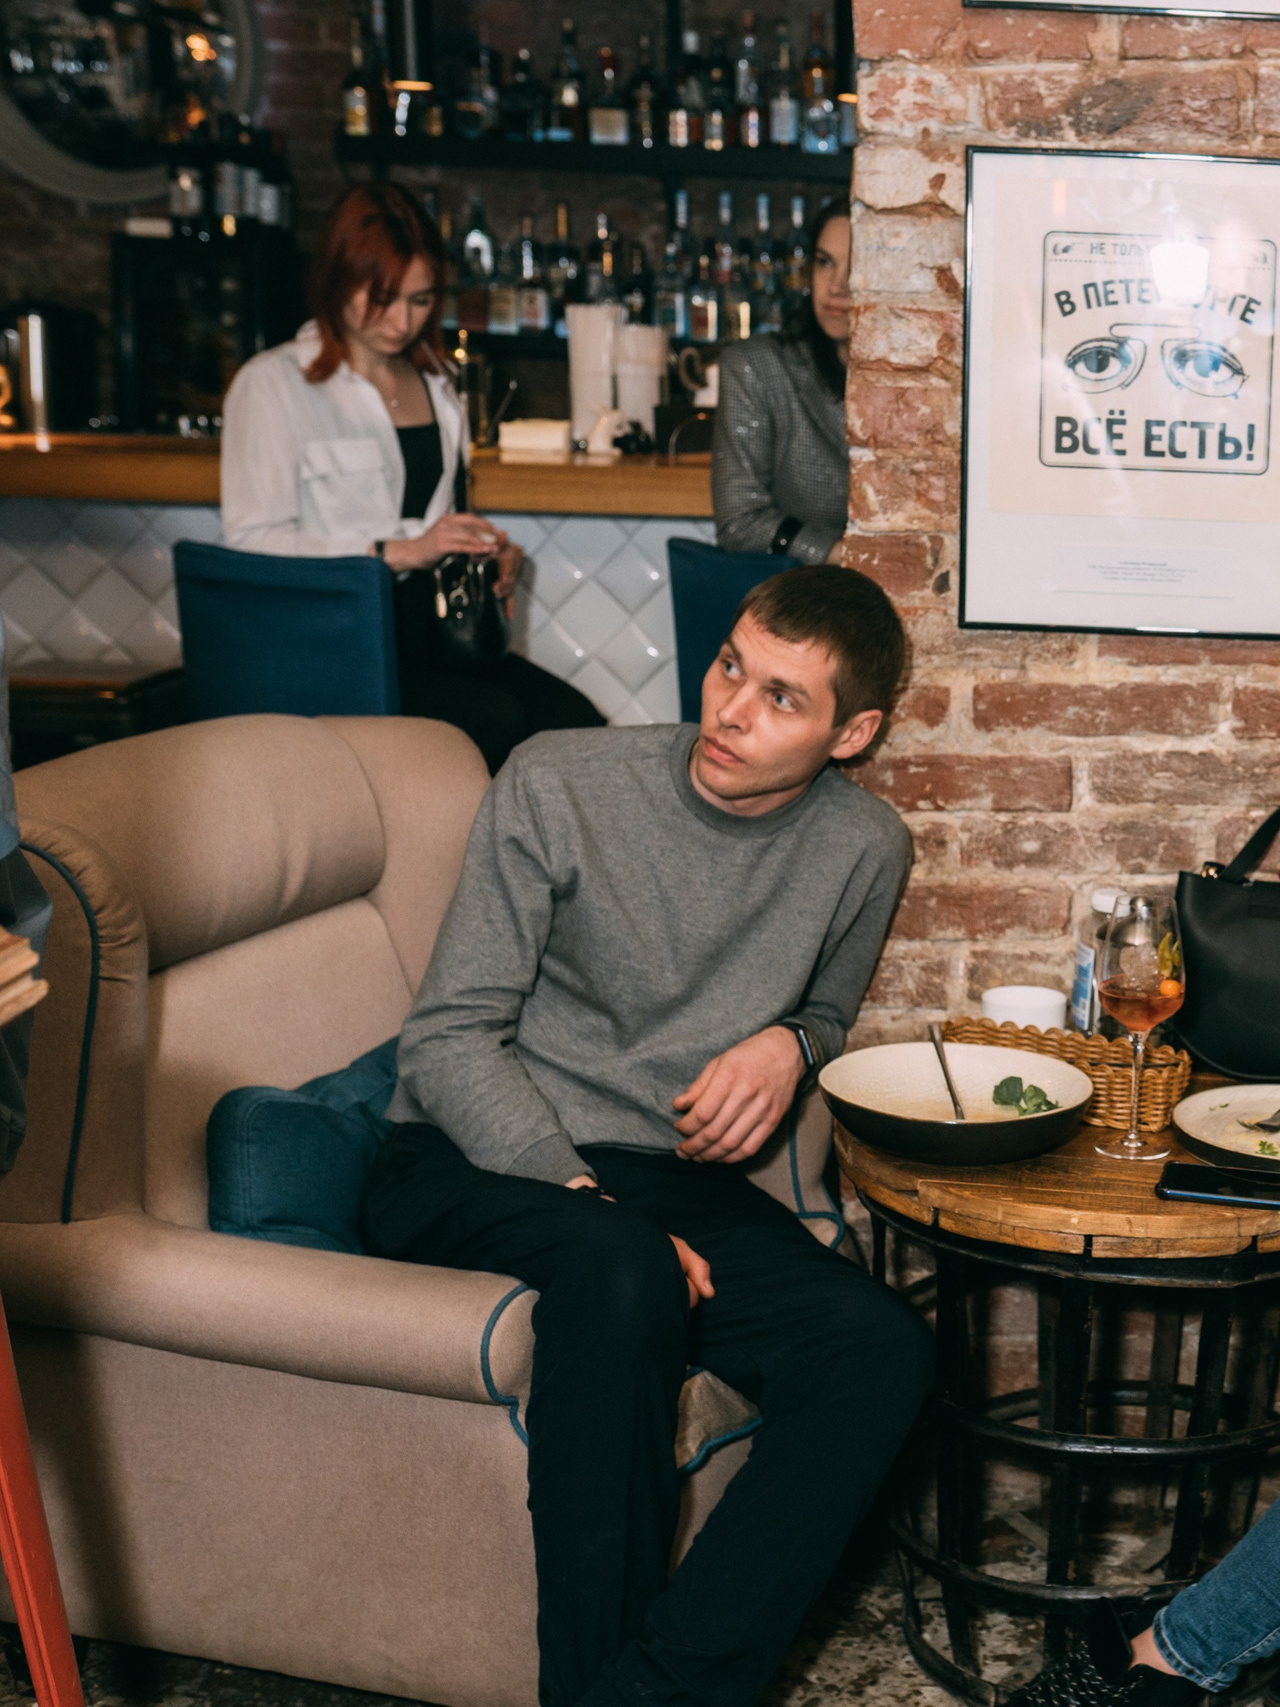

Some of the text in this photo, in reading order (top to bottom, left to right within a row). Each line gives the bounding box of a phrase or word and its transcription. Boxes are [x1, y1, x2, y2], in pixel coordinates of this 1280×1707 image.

[1090, 242, 1107, 255] НЕ
[1054, 290, 1077, 318] В
[1054, 409, 1256, 462] ВСЁ ЕСТЬ!
